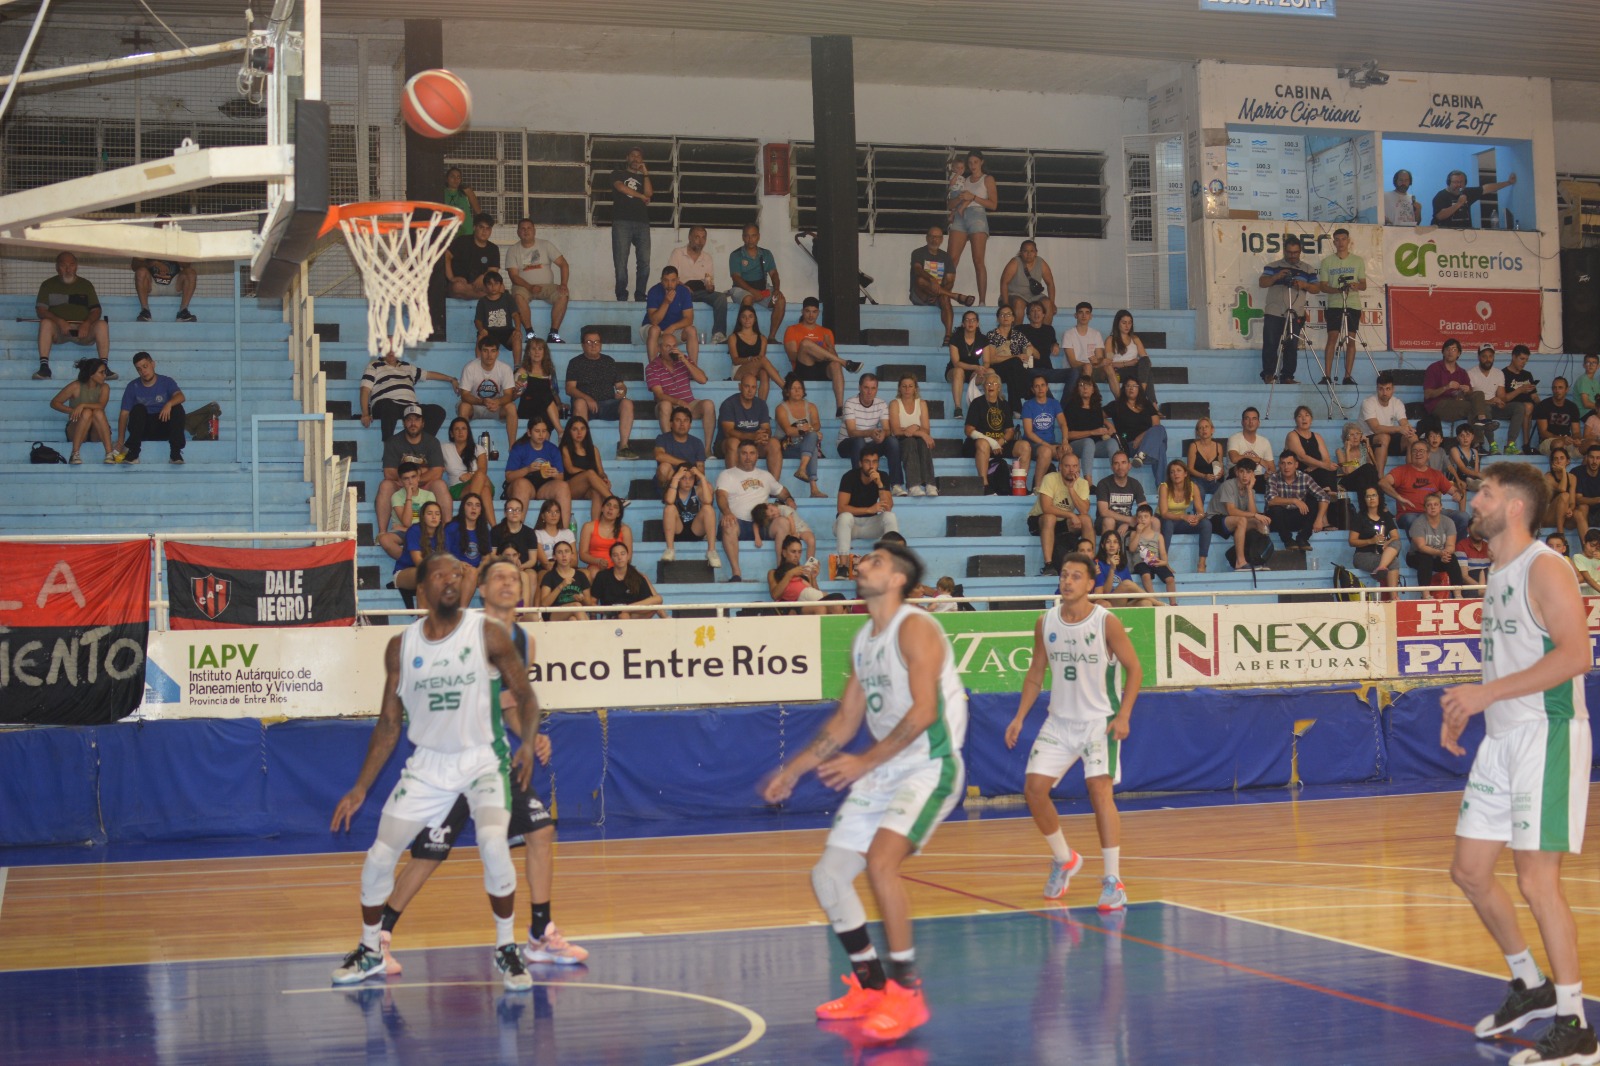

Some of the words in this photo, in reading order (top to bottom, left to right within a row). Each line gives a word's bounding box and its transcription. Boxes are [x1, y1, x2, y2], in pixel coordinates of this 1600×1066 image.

[1275, 84, 1332, 100] CABINA
[1433, 93, 1483, 109] CABINA
[1238, 98, 1288, 122] Mario
[1291, 101, 1362, 125] Cipriani
[1418, 107, 1454, 130] Luis
[1456, 111, 1497, 136] Zoff
[1437, 251, 1523, 271] entreríos
[1438, 270, 1489, 279] GOBIERNO
[265, 570, 303, 595] DALE
[257, 595, 313, 622] NEGRO!
[1234, 621, 1367, 653] NEXO
[0, 626, 144, 687] IENTO
[189, 644, 259, 669] IAPV
[527, 660, 610, 682] anco
[623, 648, 724, 679] Entre
[732, 644, 809, 676] Ríos
[1235, 656, 1368, 671] ABERTURAS
[189, 669, 232, 682] Instituto
[236, 668, 294, 682] Autárquico
[297, 667, 312, 679] de
[414, 672, 476, 692] ATENAS
[1064, 665, 1077, 681] 8
[189, 681, 262, 695] Planeamiento
[266, 683, 273, 696] y
[274, 680, 323, 692] Vivienda
[189, 695, 228, 705] Provincia
[229, 696, 240, 704] de
[245, 695, 267, 704] Entre
[428, 692, 461, 711] 25
